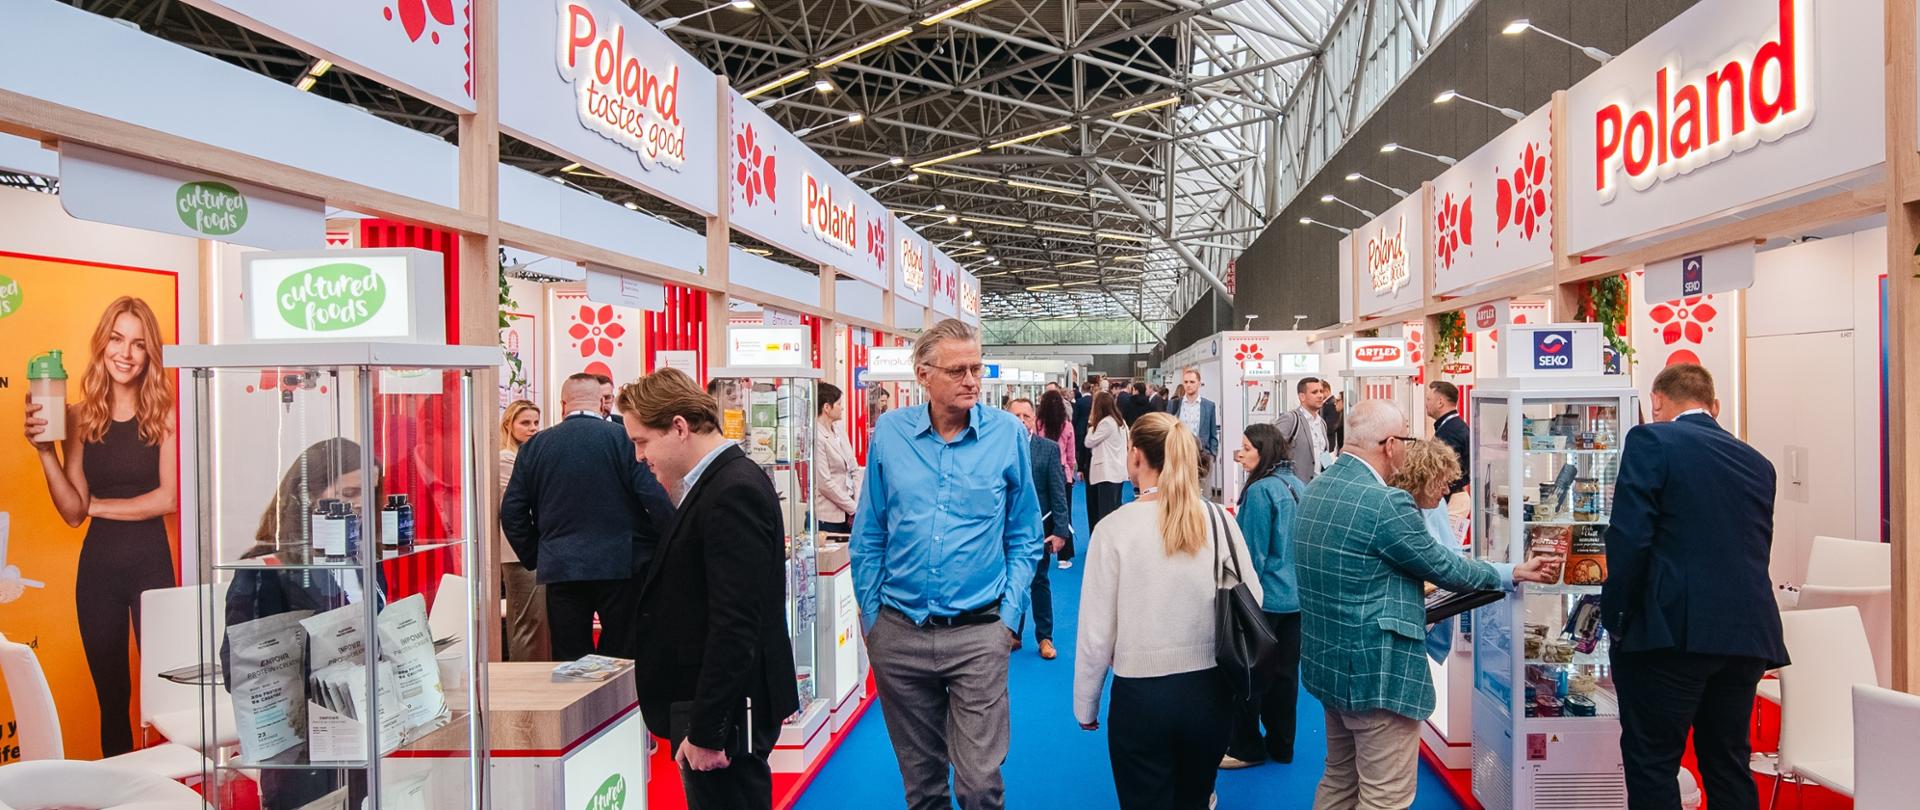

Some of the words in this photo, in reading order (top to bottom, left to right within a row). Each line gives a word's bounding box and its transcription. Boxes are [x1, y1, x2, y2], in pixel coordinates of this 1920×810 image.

[568, 5, 680, 126] Poland
[1596, 0, 1796, 191] Poland
[587, 80, 644, 138] tastes
[647, 123, 685, 160] good
[179, 185, 243, 213] cultured
[807, 175, 856, 249] Poland
[195, 209, 238, 233] foods
[903, 240, 923, 272] Poland
[1368, 216, 1402, 273] Poland
[281, 267, 378, 310] cultured
[1684, 281, 1700, 292] SEKO
[304, 299, 369, 332] foods
[1477, 309, 1495, 320] ARTLEX
[1357, 347, 1398, 356] ARTLEX
[1538, 355, 1568, 366] SEKO
